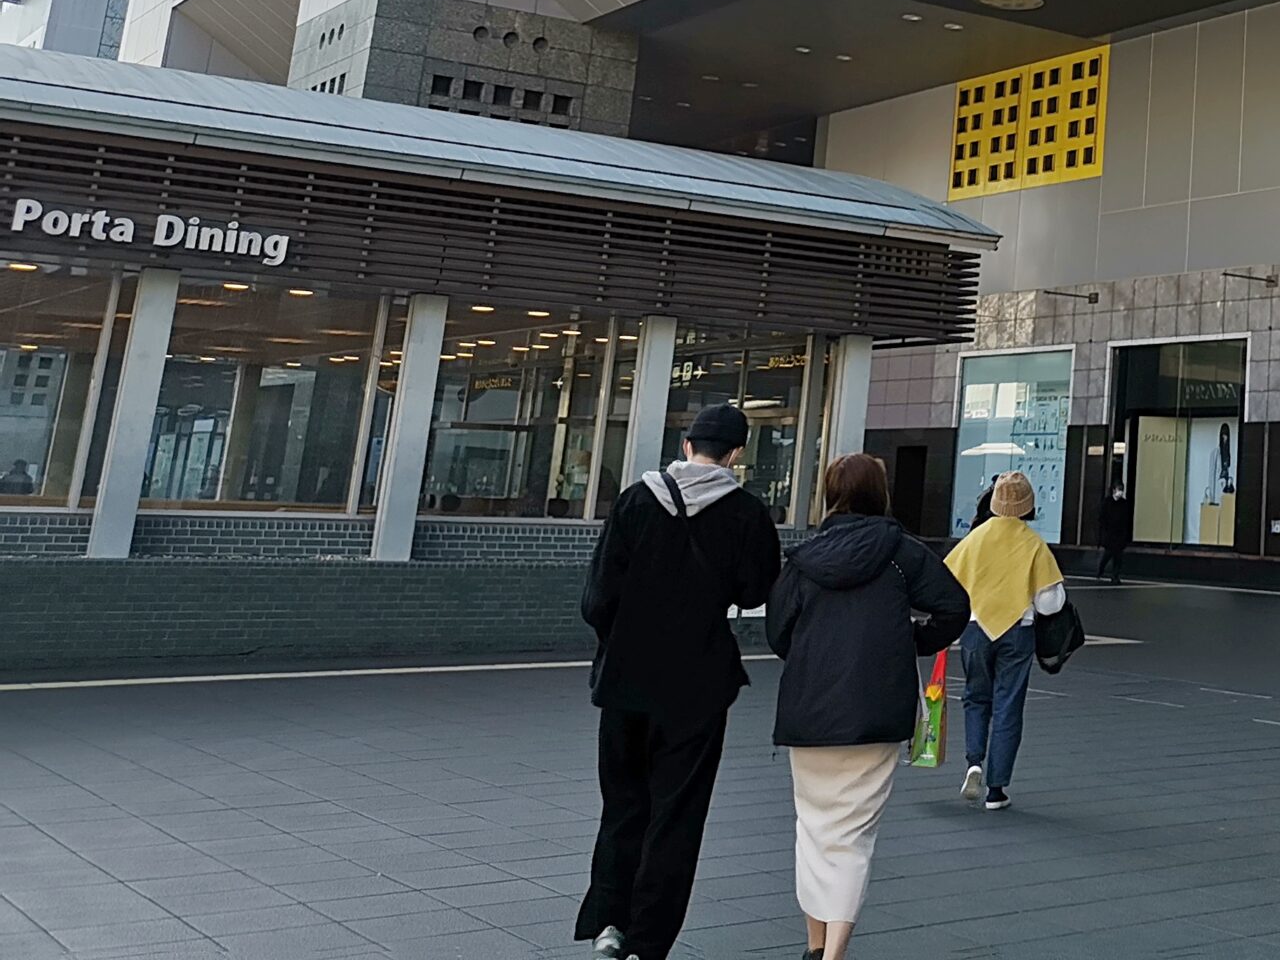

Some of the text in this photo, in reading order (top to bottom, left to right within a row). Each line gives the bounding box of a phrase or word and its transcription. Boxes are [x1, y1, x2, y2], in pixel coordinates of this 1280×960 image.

[10, 198, 290, 266] Porta Dining
[1185, 383, 1237, 400] PRADA
[1143, 434, 1183, 443] PRADA
